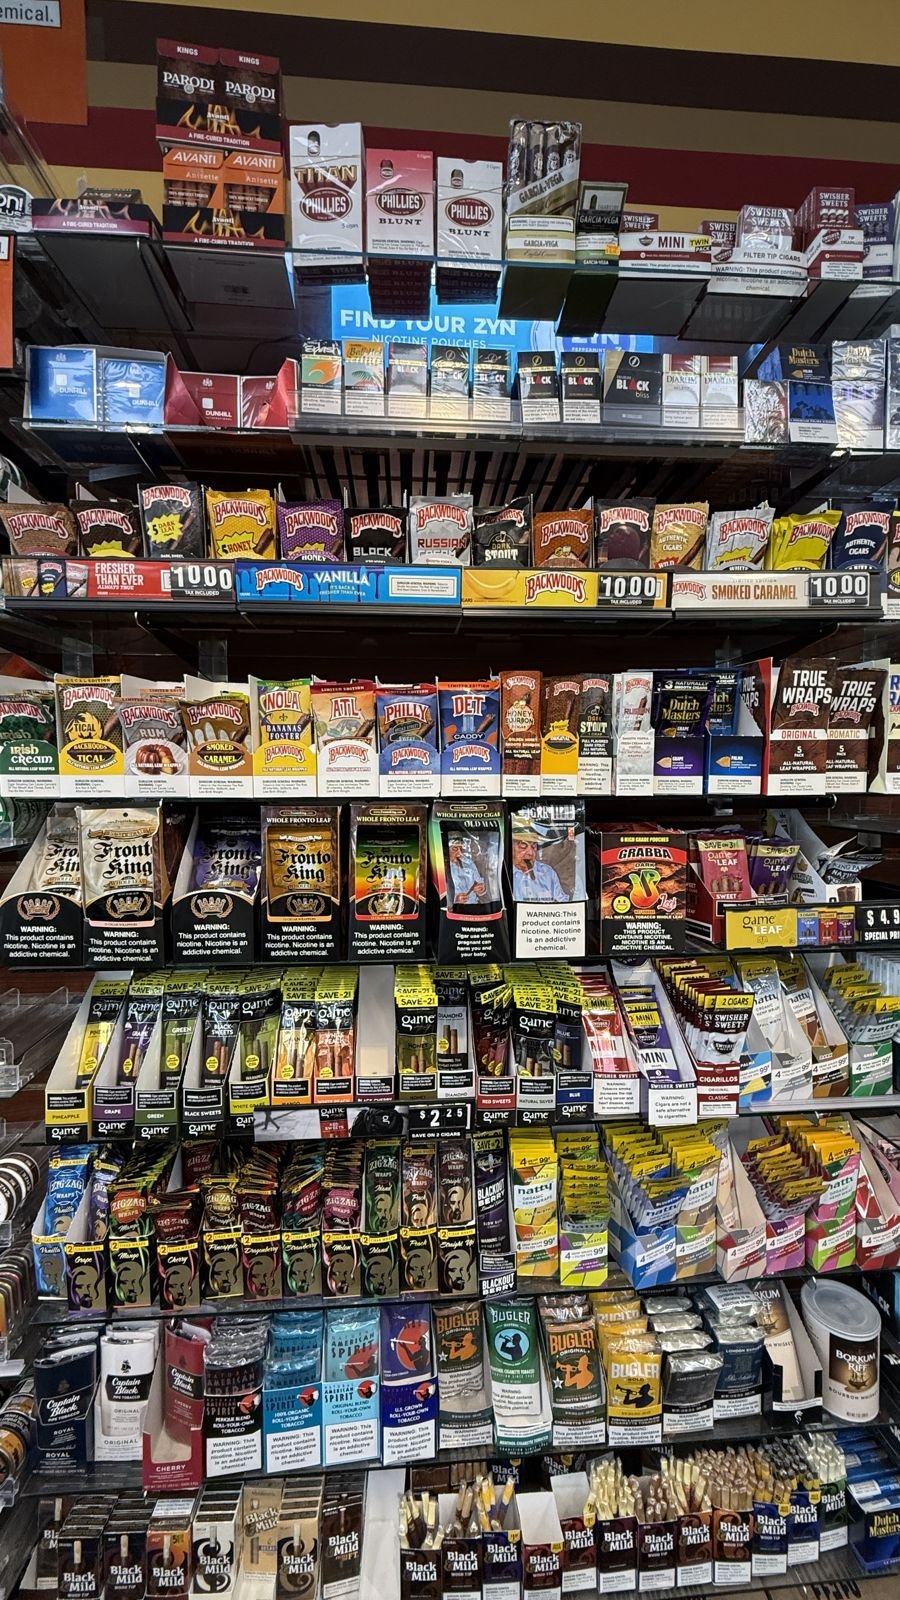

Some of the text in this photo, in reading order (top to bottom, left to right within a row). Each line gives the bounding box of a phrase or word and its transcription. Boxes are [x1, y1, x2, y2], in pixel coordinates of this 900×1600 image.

[177, 46, 198, 56] KINGS
[239, 55, 260, 66] KINGS
[163, 71, 215, 91] PARODI
[226, 80, 276, 100] PARODI
[195, 133, 250, 146] FIRE-CURED TRADITION
[172, 151, 217, 165] AVANTI
[233, 155, 276, 169] AVANTI
[186, 171, 219, 182] Anisette
[295, 165, 357, 182] TITAN
[246, 175, 279, 187] Anisette
[381, 194, 420, 209] PHILLIES
[819, 192, 850, 200] SWISHER
[306, 196, 347, 213] PHILLIES
[451, 204, 489, 220] PHILLIES
[448, 229, 490, 237] BLUNT
[658, 236, 685, 249] MINI
[690, 239, 710, 248] TWIN
[743, 252, 765, 260] FILTER
[779, 254, 801, 262] CIGARS
[341, 309, 516, 336] FIND YOUR ZYN
[791, 346, 816, 358] Dutch
[788, 357, 820, 367] Masters
[60, 387, 88, 395] DUNHILL
[635, 391, 650, 399] bliss
[213, 499, 267, 526] BACKWOODS
[416, 502, 469, 531] BACKWOODS
[7, 512, 69, 539] BACKWOODS
[77, 508, 133, 535] BACKWOODS
[350, 511, 403, 536] BACKWOODS
[719, 519, 769, 544] BACKWOODS
[228, 541, 252, 551] HONEY
[417, 537, 467, 548] RUSSIAN
[658, 535, 688, 545] AUTHENTIC
[662, 543, 684, 551] CIGARS
[484, 550, 519, 561] STOUT
[95, 563, 135, 575] FRESHER
[95, 574, 144, 590] THAN EVER
[255, 567, 304, 591] BACKWOODS
[314, 570, 370, 587] VANILLA
[524, 571, 588, 604] BACKWOODS
[712, 584, 796, 600] SMOKED CARAMEL
[792, 670, 827, 687] TRUE
[841, 681, 876, 697] TRUE
[63, 688, 115, 712] BACKWOODS
[265, 691, 299, 710] NOLA
[783, 687, 832, 704] WRAPS
[331, 696, 361, 720] ATL
[453, 695, 486, 717] DET
[670, 698, 700, 711] Dutch
[831, 698, 876, 714] WRAPS
[384, 702, 431, 724] PHILLY
[507, 709, 532, 718] HONEY
[663, 709, 701, 721] Masters
[74, 722, 95, 735] TICAL
[139, 727, 165, 738] RUM
[266, 723, 302, 733] BANANAS
[270, 732, 300, 740] FOSTER
[454, 732, 484, 741] CADDY
[781, 731, 818, 740] ORIGINAL
[206, 744, 234, 752] SMOKED
[77, 752, 106, 763] TICAL
[204, 754, 238, 764] CARAMEL
[356, 815, 420, 824] WHOLE FRONTO LEAF
[618, 848, 673, 861] GRABBA
[522, 919, 581, 929] product contains
[743, 914, 775, 933] game
[553, 927, 581, 935] Nicotine
[753, 926, 783, 935] LEAF
[865, 932, 888, 940] SPECIAL
[20, 934, 44, 943] product
[45, 933, 73, 941] contains
[4, 942, 58, 950] nicotine. Nicotine
[402, 1013, 435, 1031] game
[715, 1012, 748, 1022] SWISHER
[520, 1014, 553, 1033] game
[715, 1021, 747, 1030] SWEETS
[641, 1048, 668, 1064] MINI
[700, 1075, 738, 1083] CIGARILLOS
[204, 1109, 222, 1117] SWEETS
[483, 1112, 508, 1124] game
[51, 1127, 81, 1142] game
[517, 1182, 552, 1196] natty
[209, 1244, 238, 1252] Pineapple
[168, 1255, 188, 1264] Cherry
[482, 1273, 515, 1290] BLACKOUT
[482, 1282, 515, 1296] BERRY
[437, 1313, 479, 1330] BUGLER
[491, 1310, 530, 1325] BUGLER
[551, 1330, 595, 1354] BUGLER
[836, 1350, 876, 1363] BORKUM
[611, 1363, 659, 1377] BUGLER
[847, 1362, 868, 1374] RIFF
[112, 1379, 140, 1390] Captain
[115, 1387, 138, 1396] Black
[47, 1394, 80, 1411] Captain
[51, 1404, 78, 1417] Black
[104, 1437, 138, 1446] ORIGINAL
[156, 1464, 186, 1473] CHERRY
[720, 1521, 750, 1533] Black
[330, 1532, 359, 1546] Black
[725, 1530, 750, 1541] Mild
[334, 1541, 360, 1556] Mild
[64, 1572, 95, 1583] Black
[70, 1581, 96, 1592] Mild
